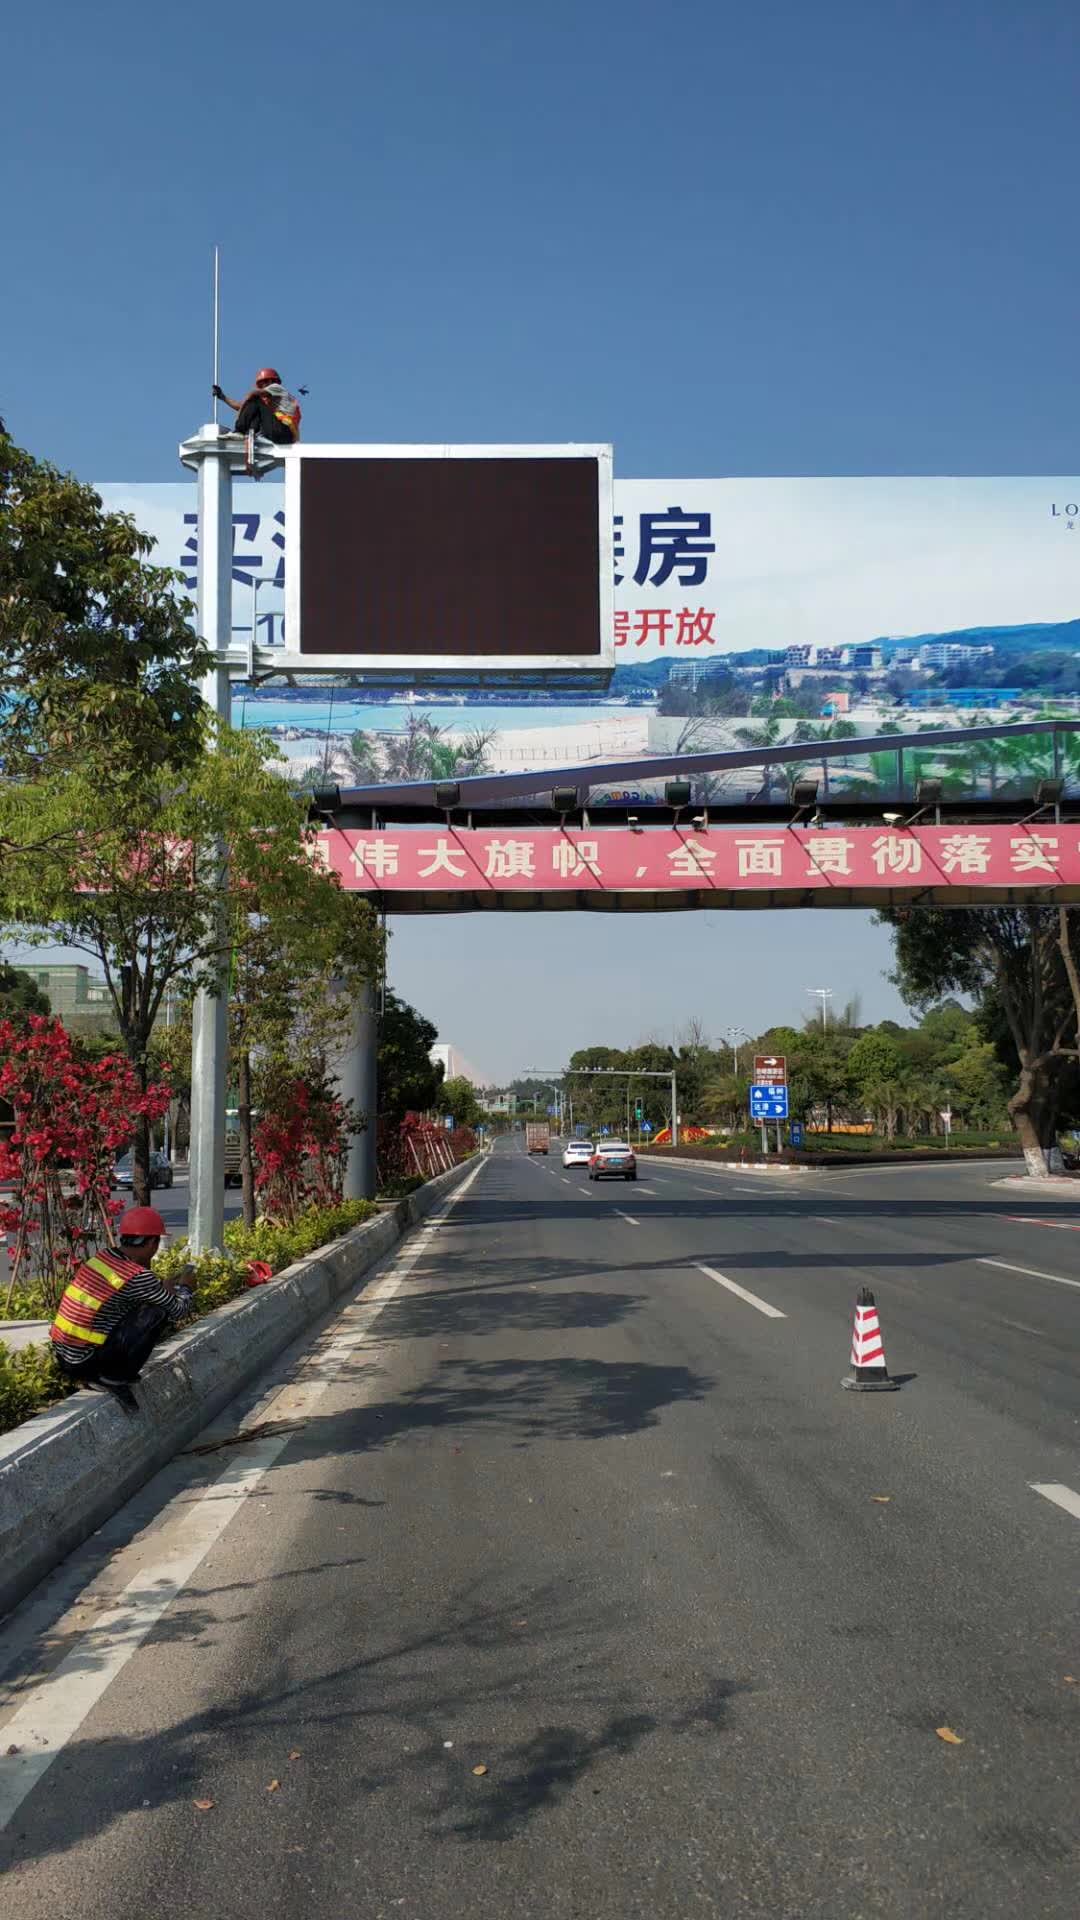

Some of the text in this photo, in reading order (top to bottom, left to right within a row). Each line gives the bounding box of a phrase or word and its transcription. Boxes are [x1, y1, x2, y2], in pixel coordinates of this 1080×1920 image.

[180, 511, 285, 589] 买
[306, 834, 1080, 879] 伟大旗帜，全面贯彻落实
